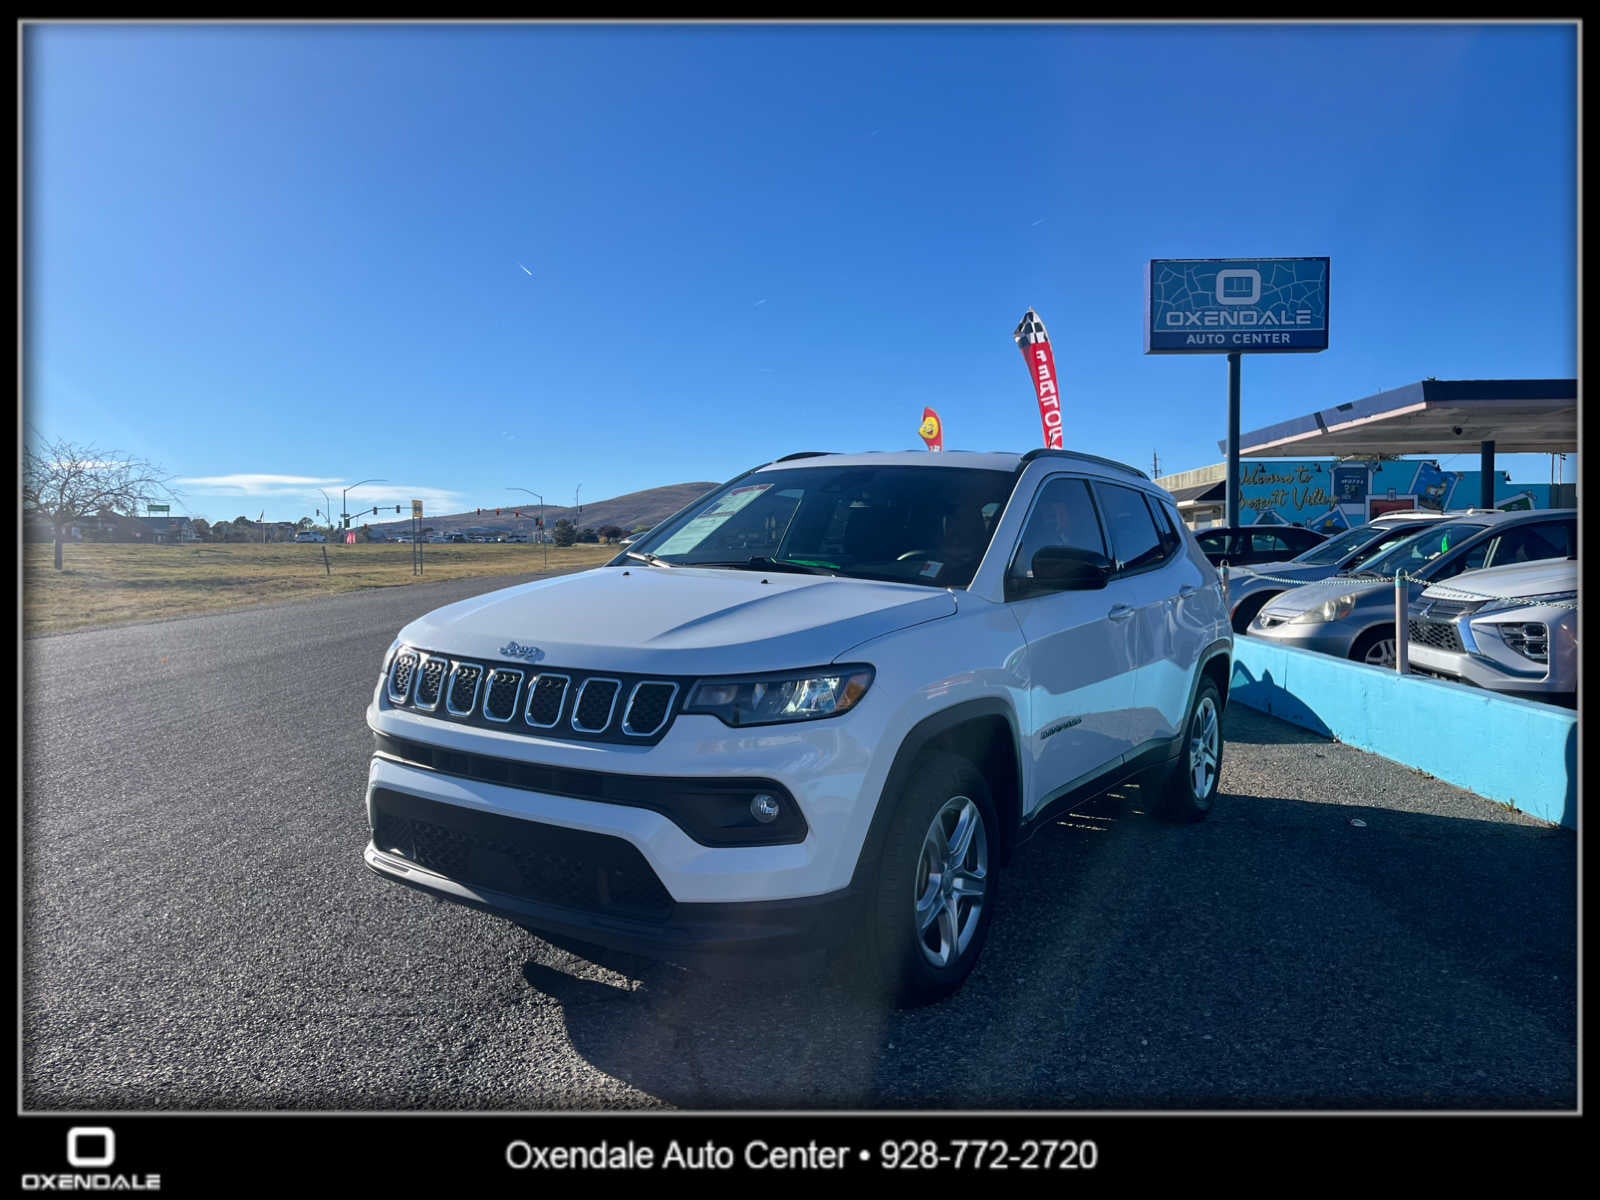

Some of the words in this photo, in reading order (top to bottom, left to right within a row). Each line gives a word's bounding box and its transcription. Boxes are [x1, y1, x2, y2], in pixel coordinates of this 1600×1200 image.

[1166, 309, 1312, 326] OXENDALE
[1186, 334, 1225, 345] AUTO
[1232, 333, 1291, 344] CENTER
